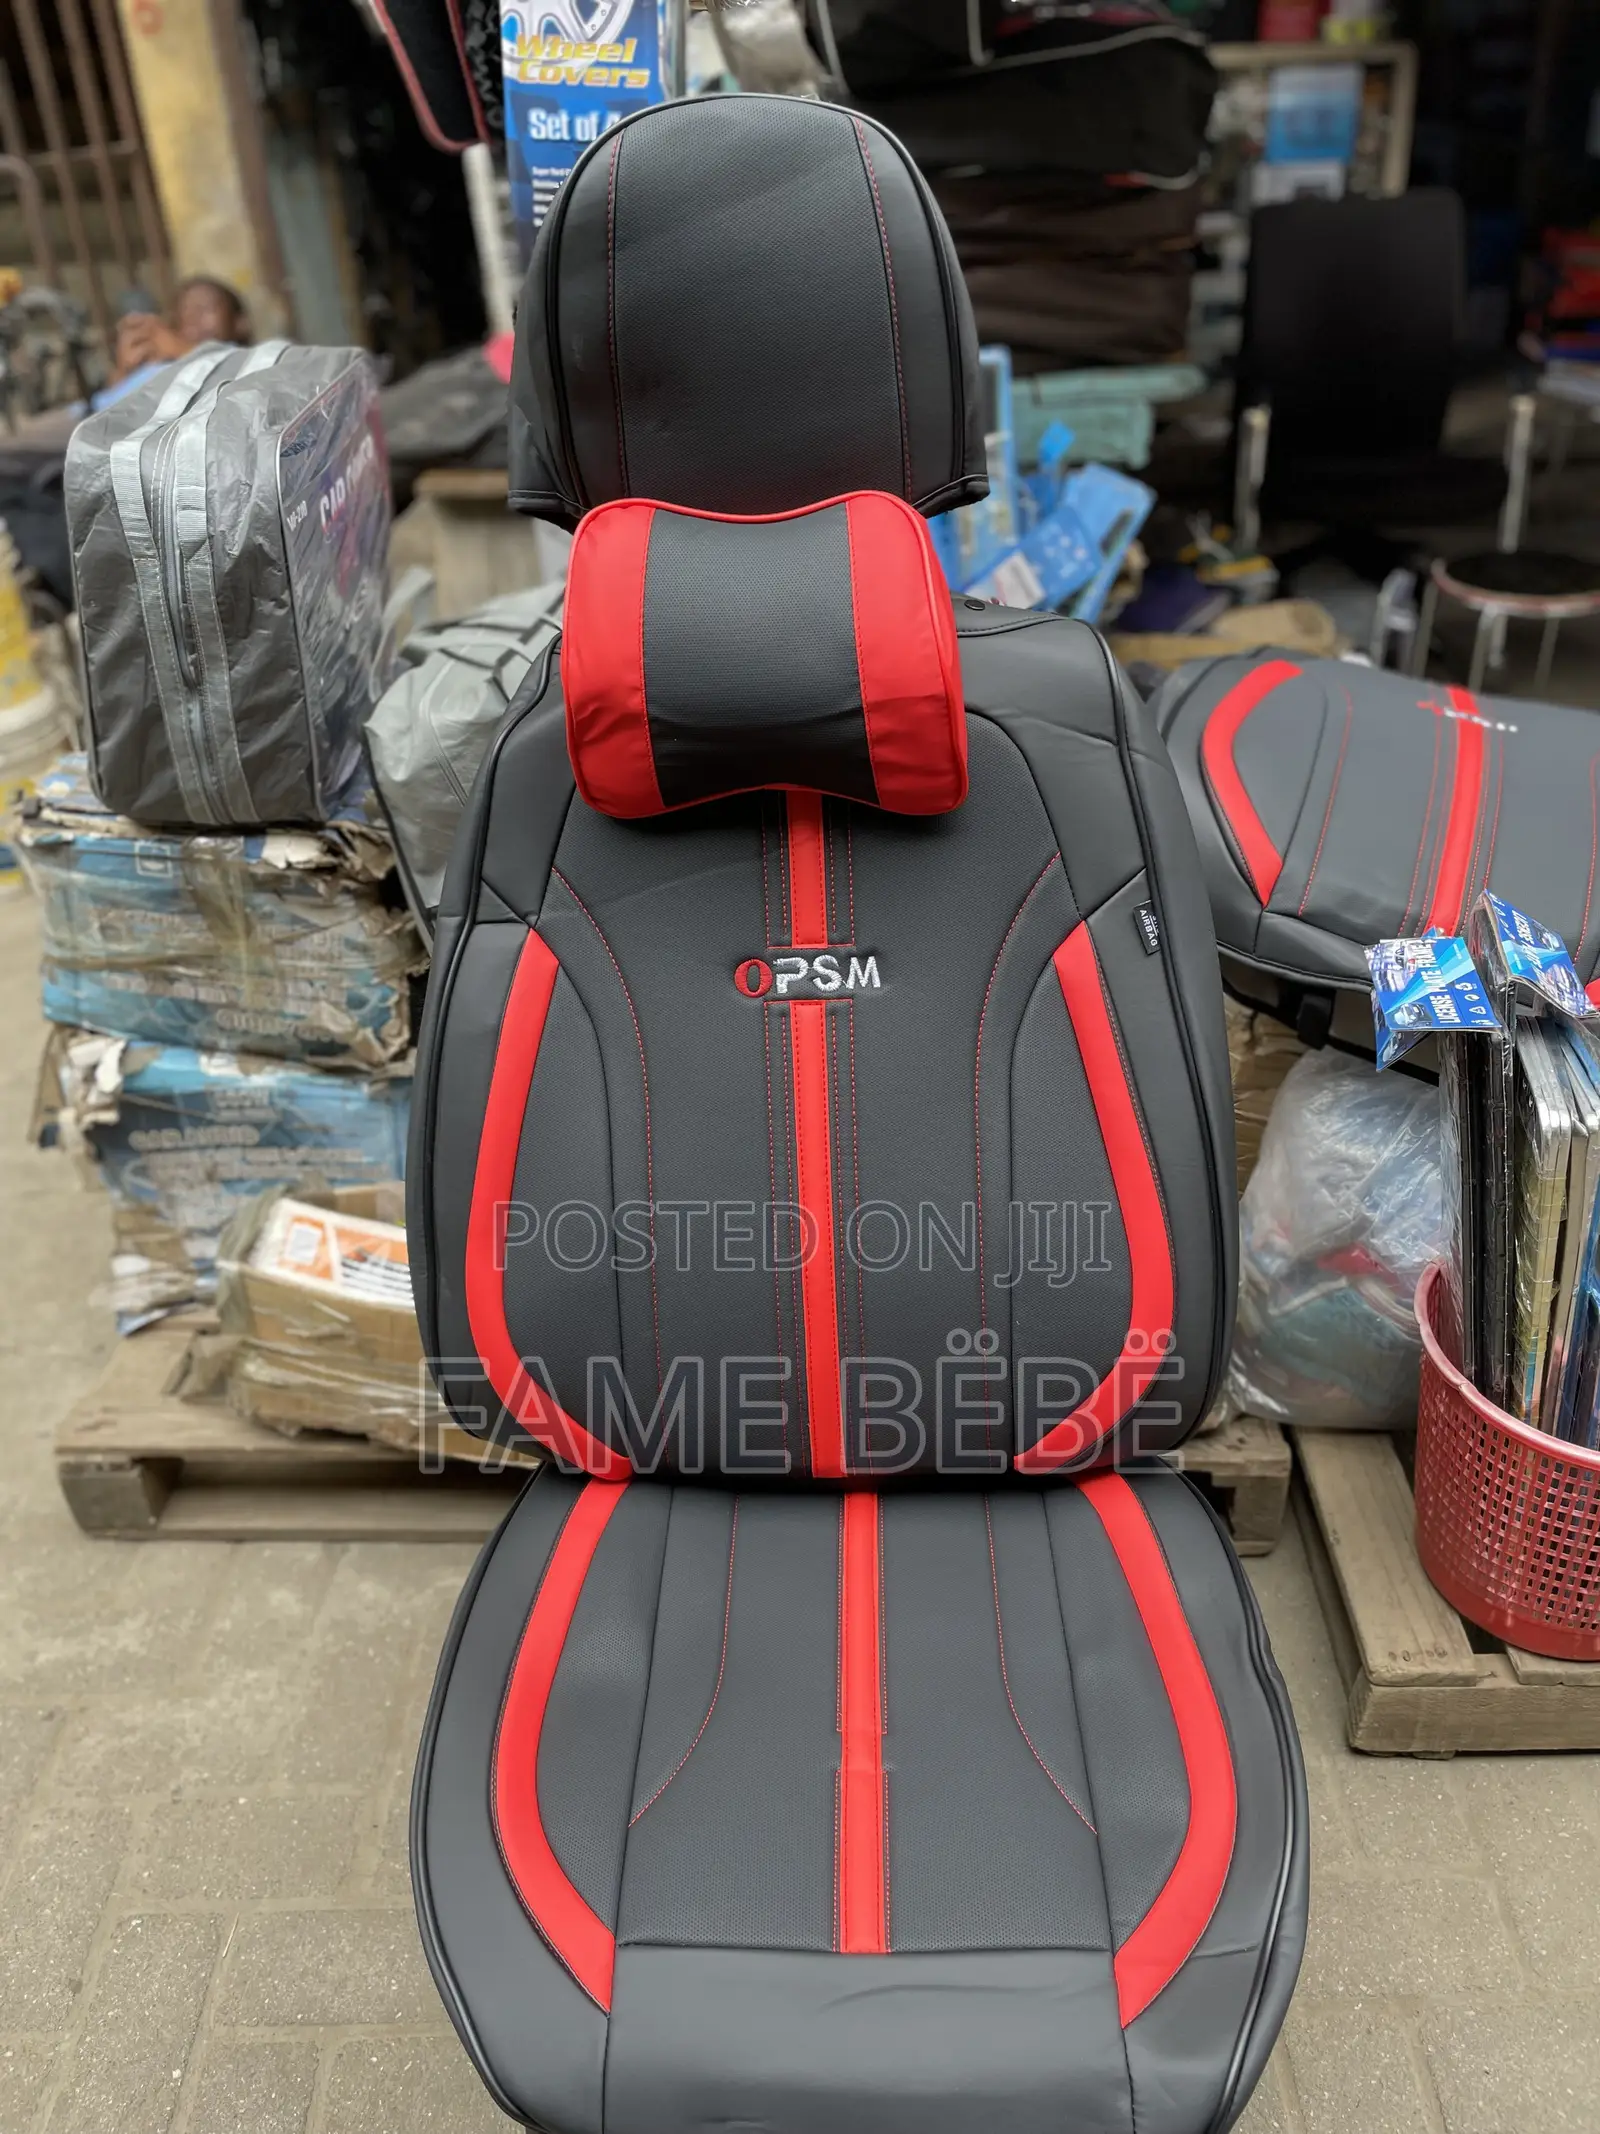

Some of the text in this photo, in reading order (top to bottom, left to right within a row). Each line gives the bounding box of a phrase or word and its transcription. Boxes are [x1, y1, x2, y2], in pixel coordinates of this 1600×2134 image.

[517, 34, 637, 63] Wheel
[517, 59, 650, 88] Covers
[528, 107, 570, 140] Set
[575, 110, 598, 141] of
[1140, 909, 1158, 946] AIRBAG
[733, 954, 882, 998] OPSM
[1429, 994, 1461, 1024] LICENSE
